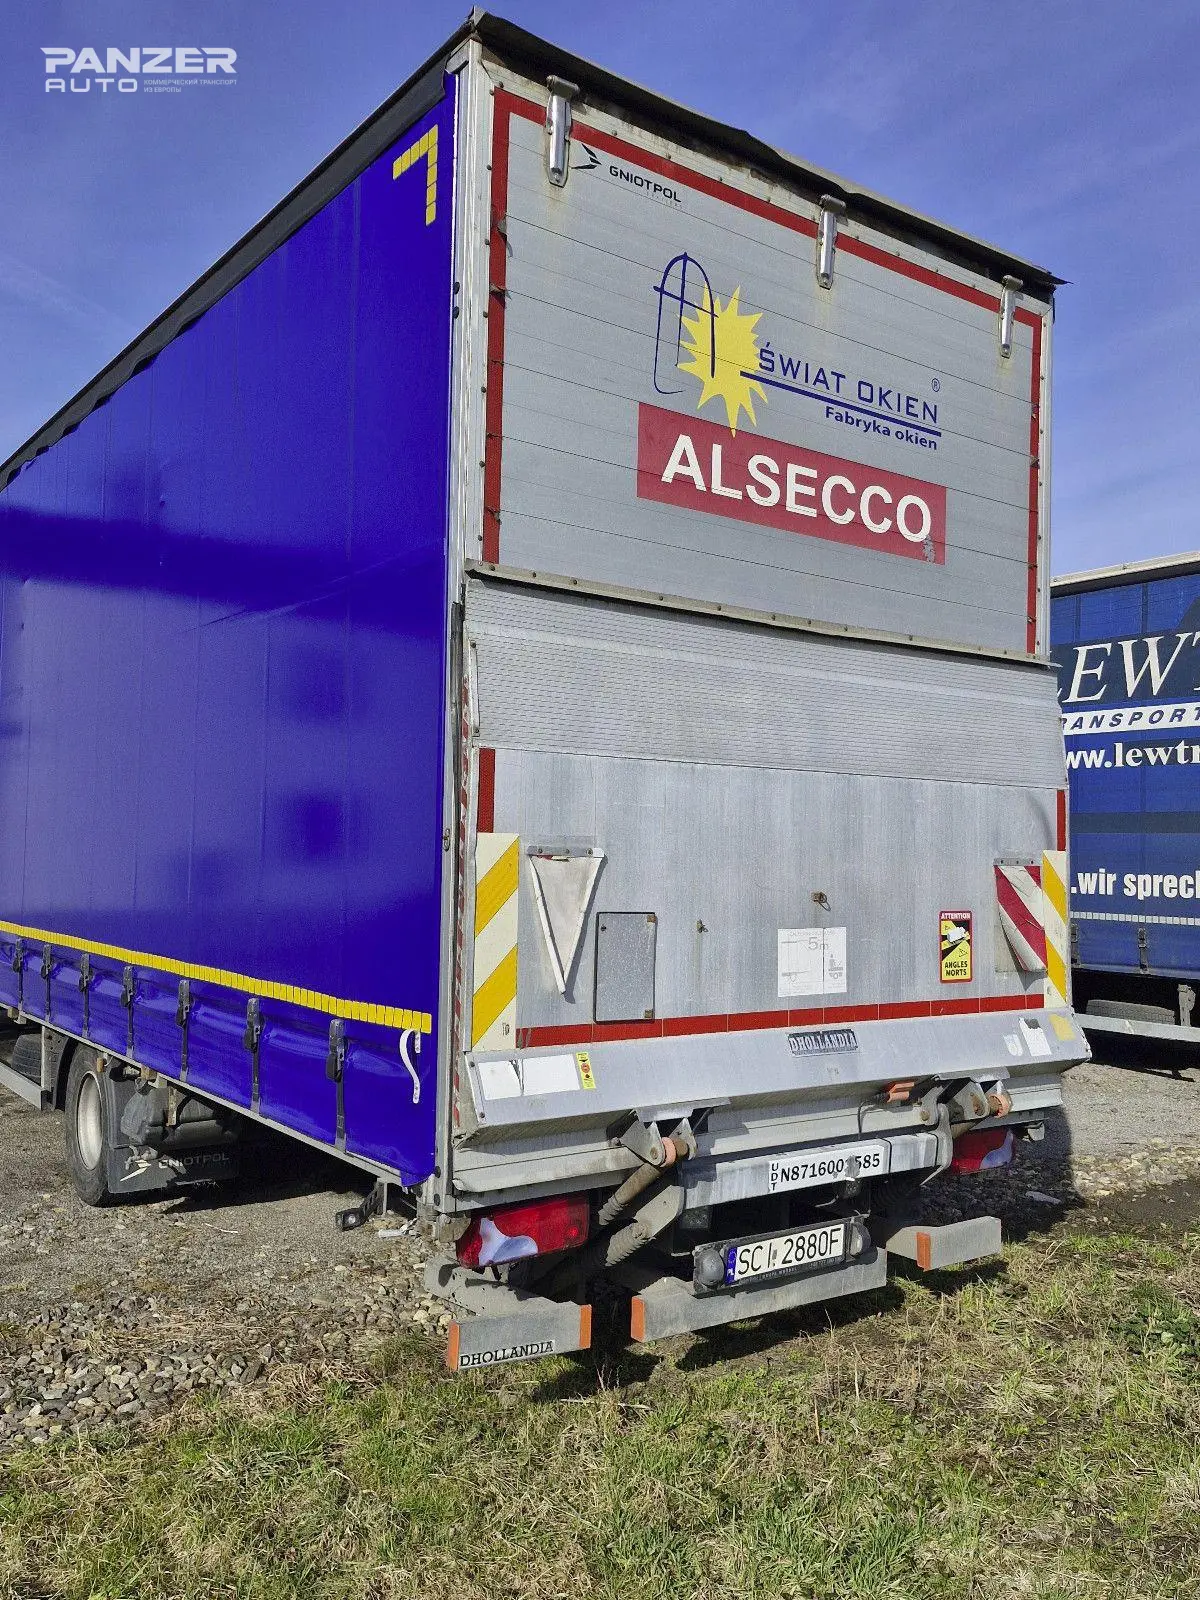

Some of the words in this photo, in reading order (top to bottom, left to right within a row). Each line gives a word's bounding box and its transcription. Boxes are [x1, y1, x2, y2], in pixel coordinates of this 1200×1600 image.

[609, 165, 682, 203] GNIOTPOL
[759, 341, 846, 394] ŚWIAT
[857, 380, 938, 424] OKIEN
[825, 405, 891, 437] Fabryka
[894, 429, 938, 450] okien
[661, 434, 932, 543] ALSECCO
[940, 912, 971, 920] ATTENTION
[788, 1032, 858, 1052] DHOLLANDIA
[781, 1228, 841, 1265] 2880F
[460, 1341, 553, 1367] DHOLLANDIA
